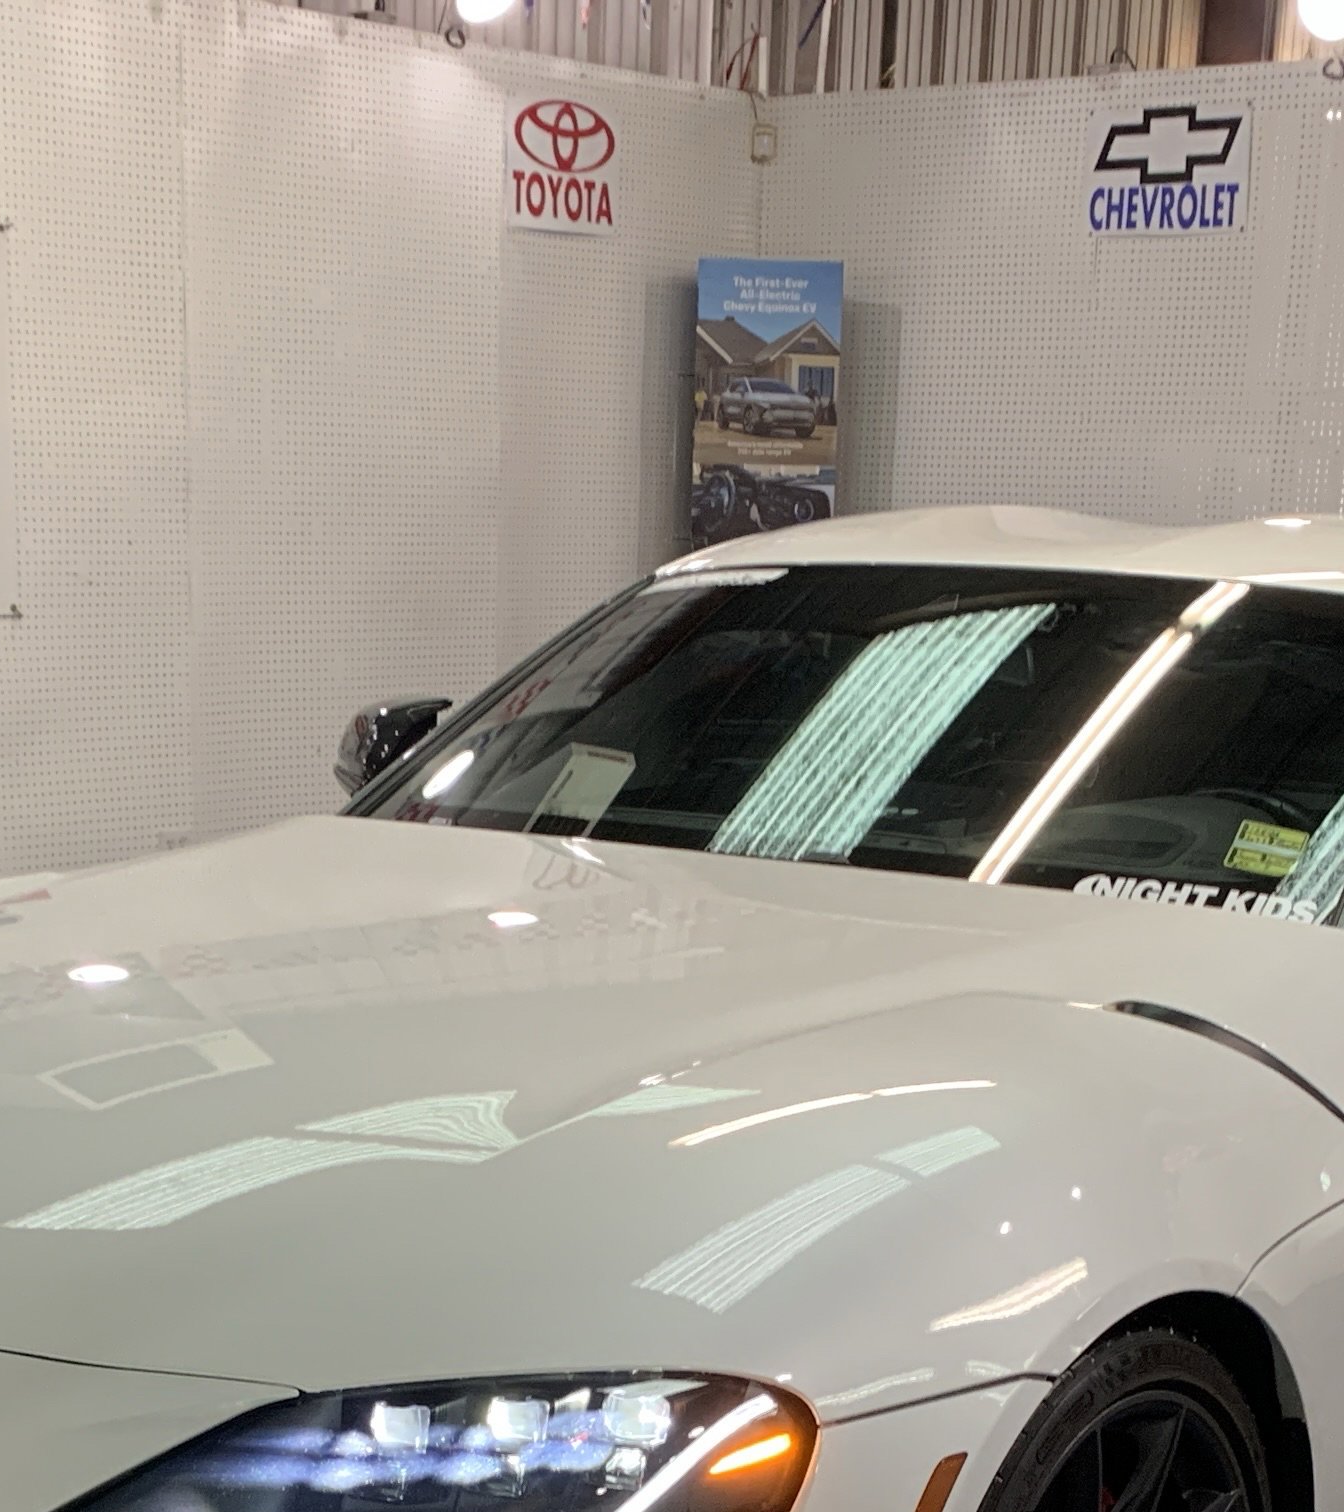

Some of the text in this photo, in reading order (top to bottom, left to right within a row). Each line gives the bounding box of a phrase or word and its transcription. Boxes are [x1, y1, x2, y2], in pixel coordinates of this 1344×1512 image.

[513, 170, 613, 226] TOYOTA
[1090, 183, 1239, 232] CHEVROLET
[723, 301, 755, 313] Chevy
[733, 276, 809, 289] The First-Ever
[1092, 874, 1318, 924] NIGHT KIDS
